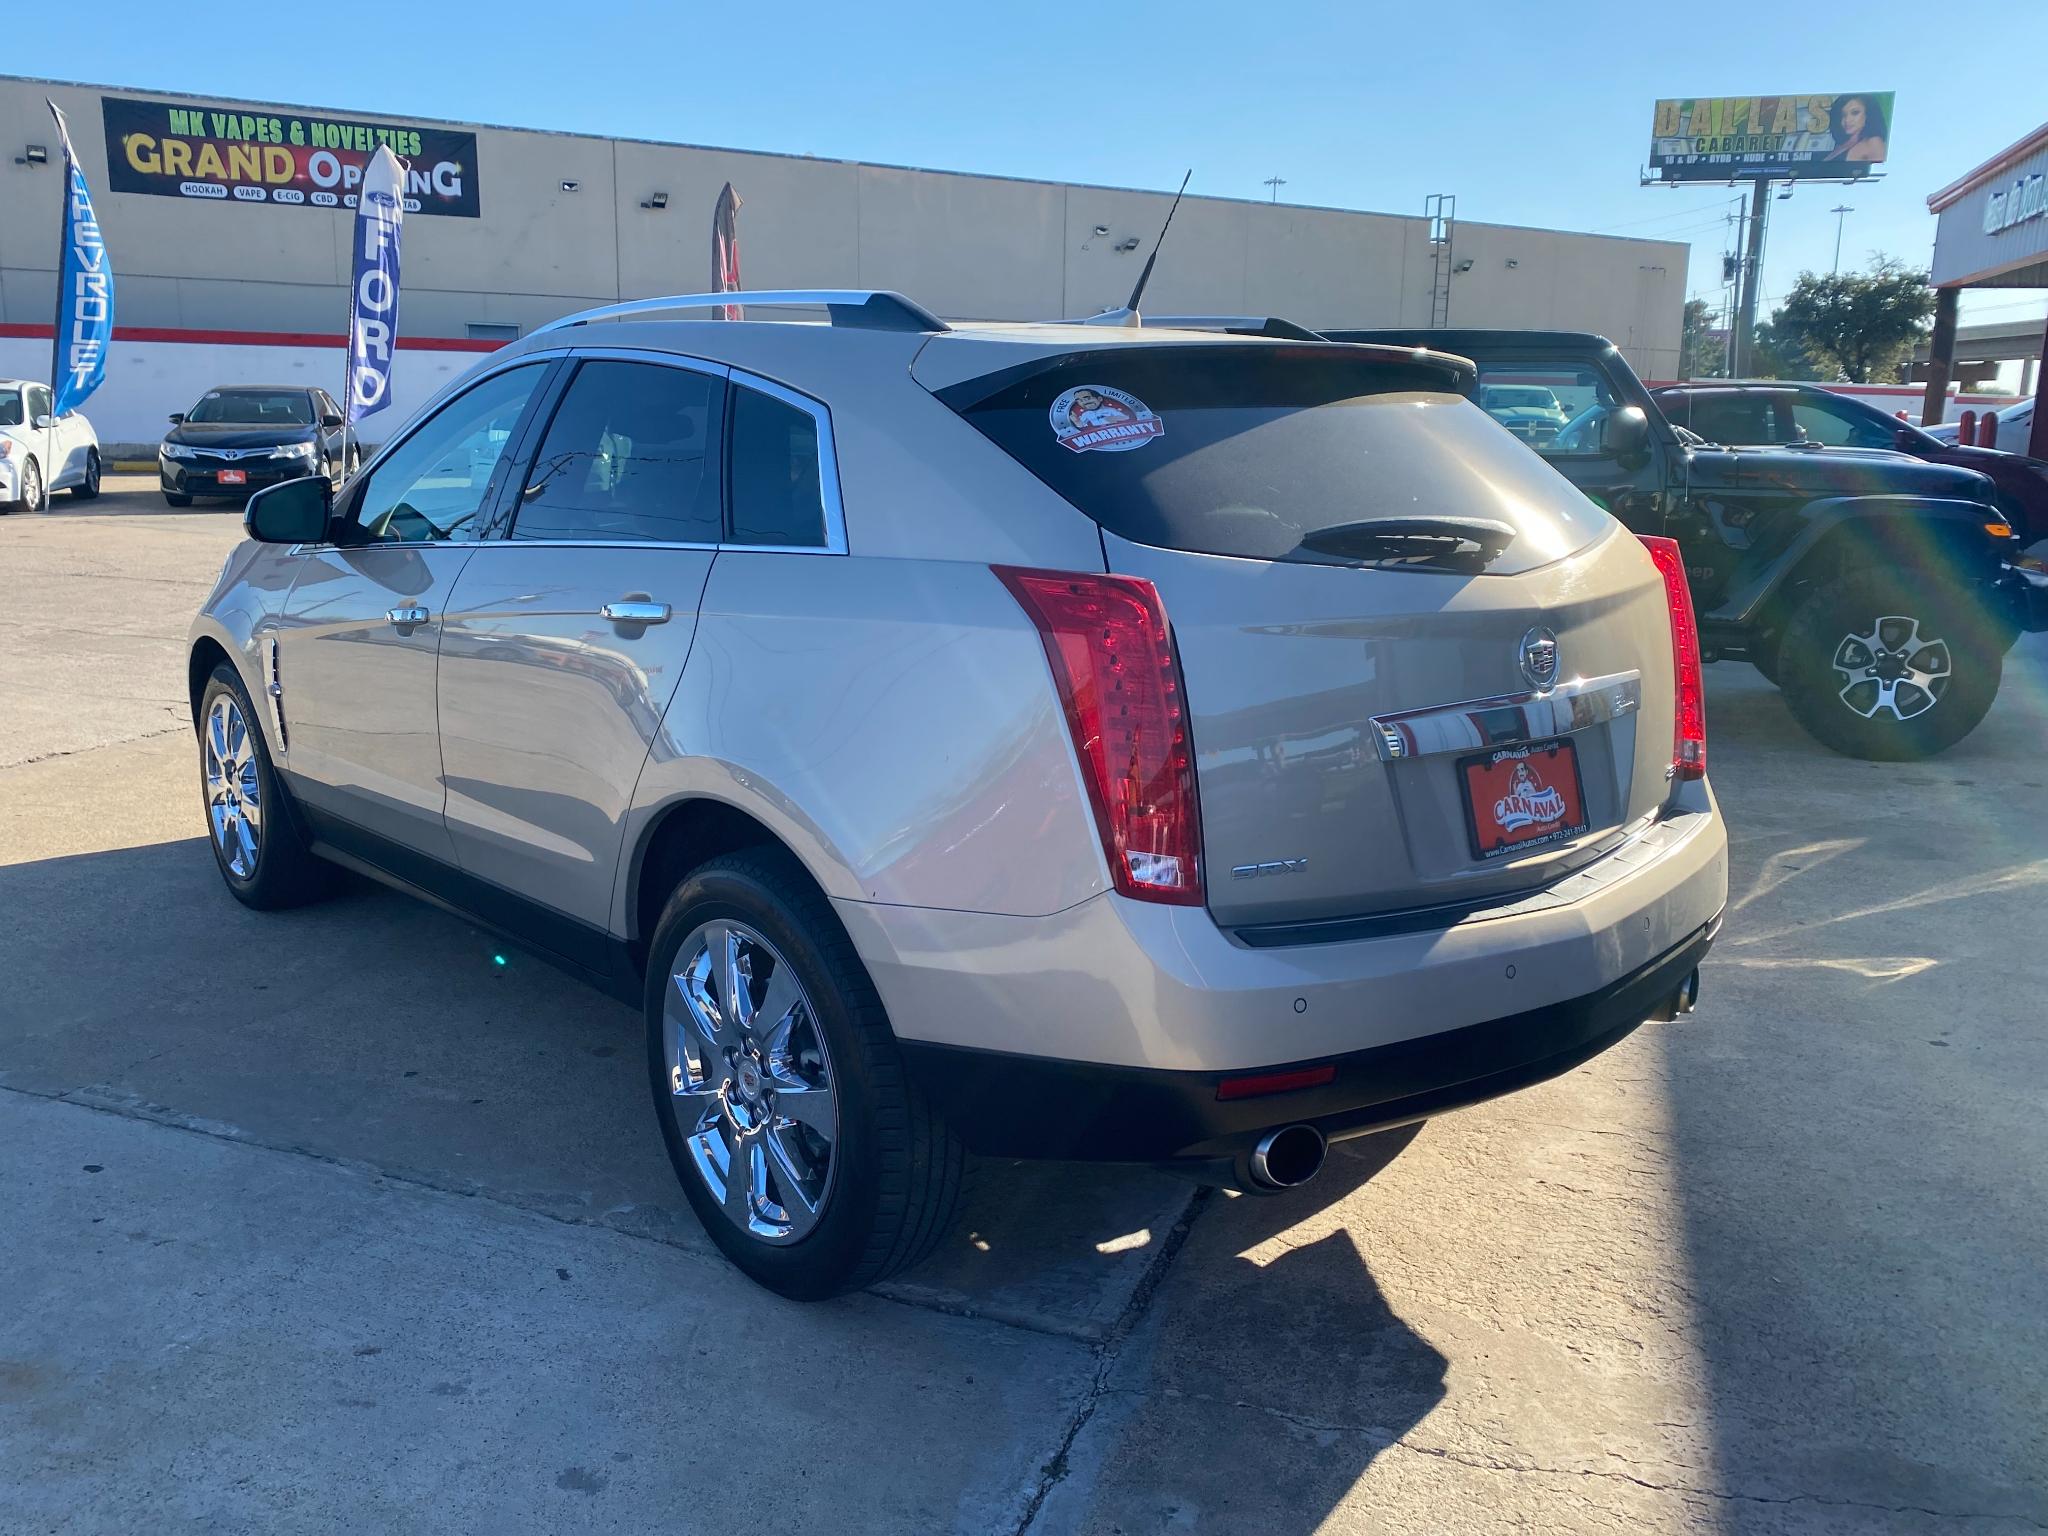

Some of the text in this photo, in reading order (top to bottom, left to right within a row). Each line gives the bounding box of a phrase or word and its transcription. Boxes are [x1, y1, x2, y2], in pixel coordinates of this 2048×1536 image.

[1655, 95, 1833, 137] DALLAS
[169, 109, 422, 156] MK VAPES & NOVELTIES
[1695, 134, 1786, 153] CABARET
[126, 133, 463, 198] GRAND OPING
[1686, 155, 1698, 164] UP
[1744, 152, 1765, 162] NUDE
[1778, 151, 1790, 161] TIL
[185, 184, 223, 195] HOOKAH
[239, 188, 262, 198] VAPE
[277, 191, 300, 201] E-CIG
[315, 194, 333, 204] CBD
[354, 218, 395, 407] FORD
[1056, 389, 1135, 413] FREE LIMITED
[1072, 422, 1156, 448] WARRANTY
[1492, 748, 1531, 761] CARNAVAL
[1494, 792, 1565, 823] CARNAVAL
